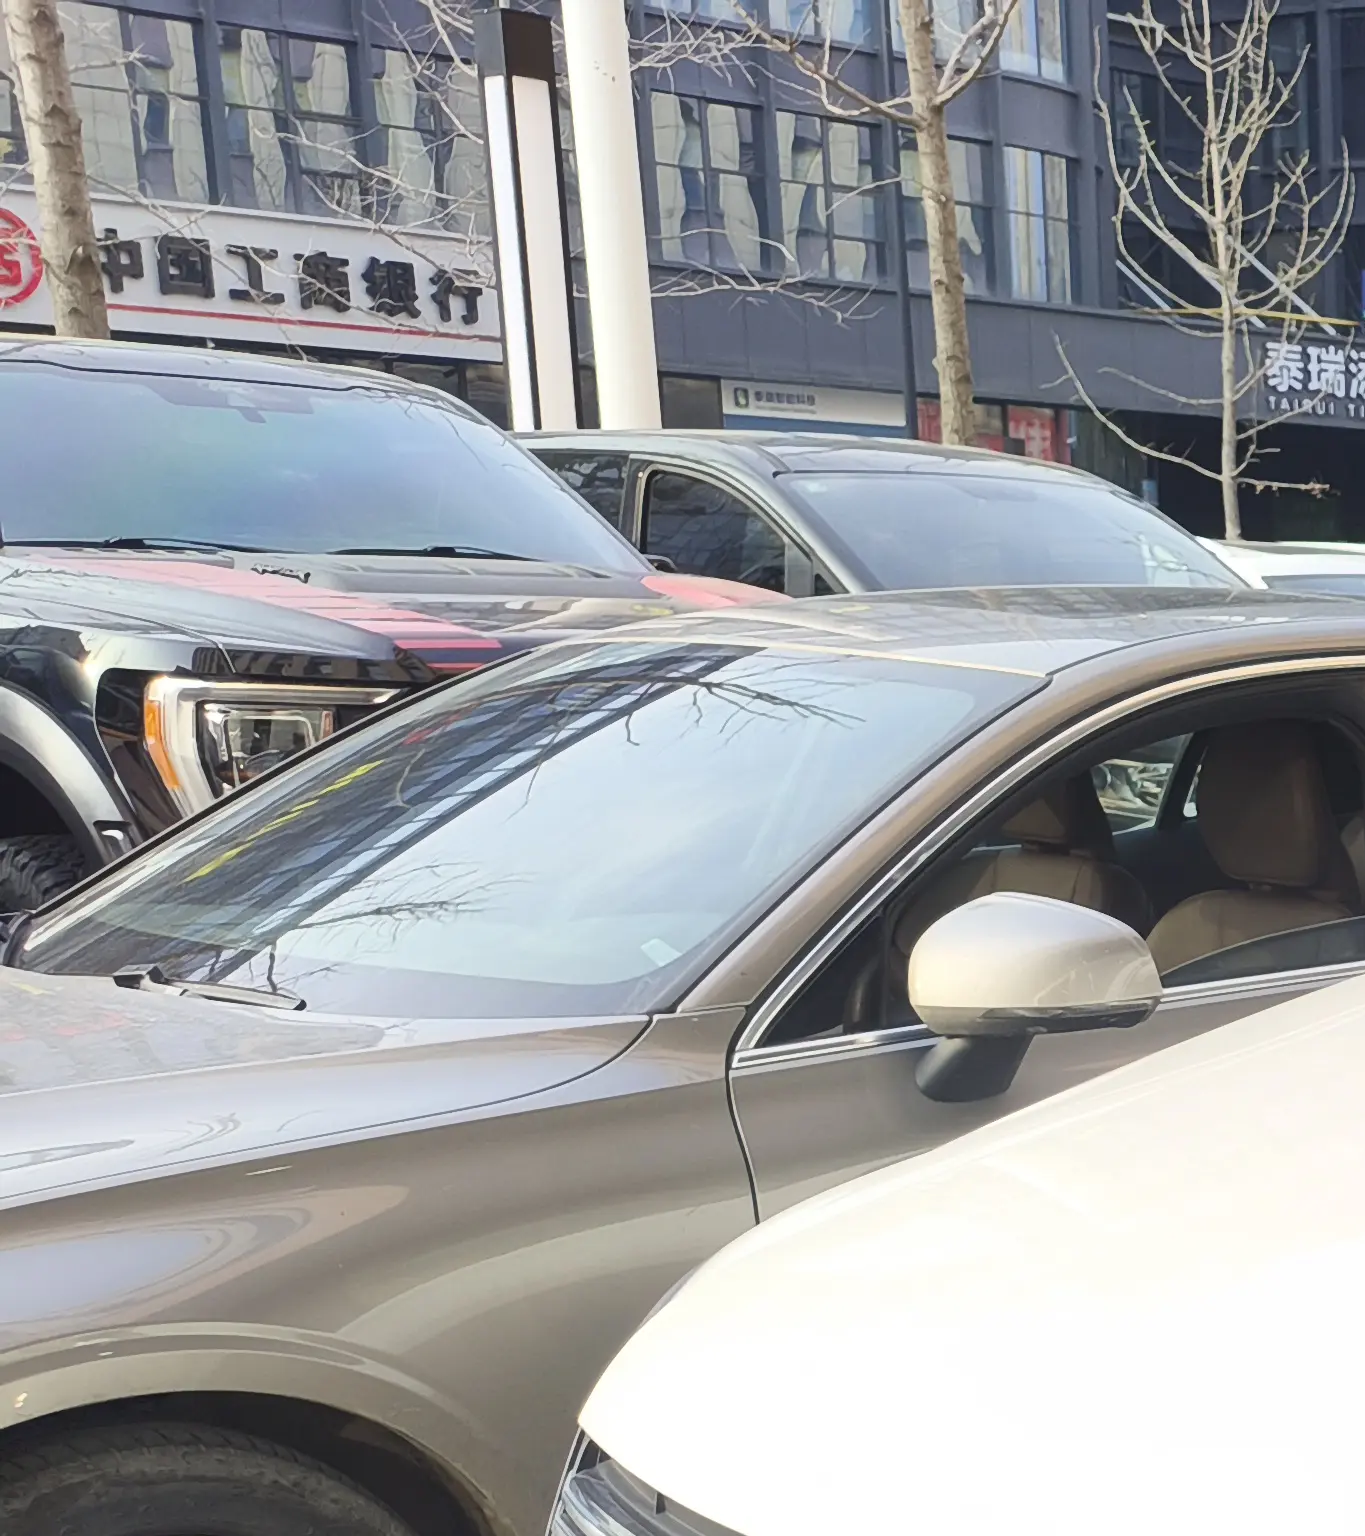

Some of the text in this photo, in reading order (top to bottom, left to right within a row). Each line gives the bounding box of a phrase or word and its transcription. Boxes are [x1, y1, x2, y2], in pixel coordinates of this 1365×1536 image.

[98, 227, 484, 325] 中国工商银行
